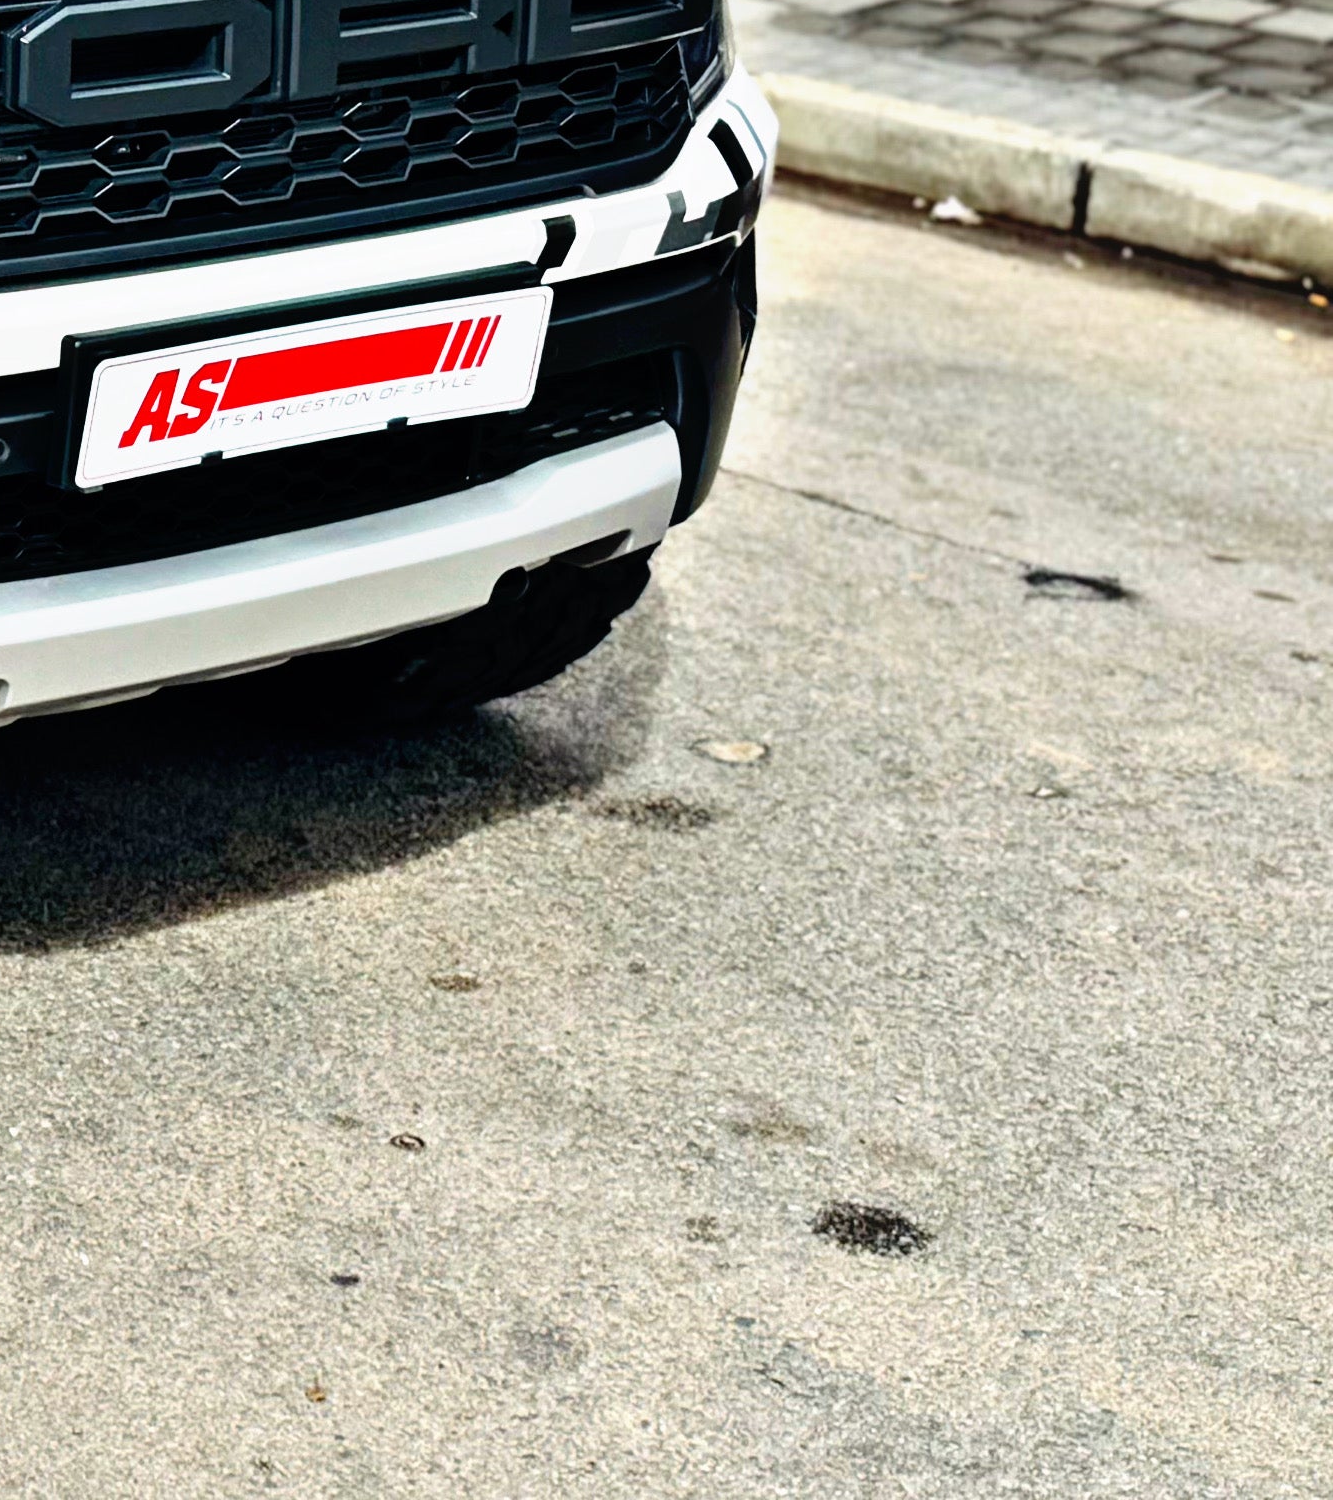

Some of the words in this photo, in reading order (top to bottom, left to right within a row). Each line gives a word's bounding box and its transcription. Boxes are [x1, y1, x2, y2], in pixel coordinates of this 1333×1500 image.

[118, 358, 232, 449] AS
[271, 390, 372, 420] QUESTION
[379, 386, 407, 400] OF
[411, 373, 478, 396] STYLE
